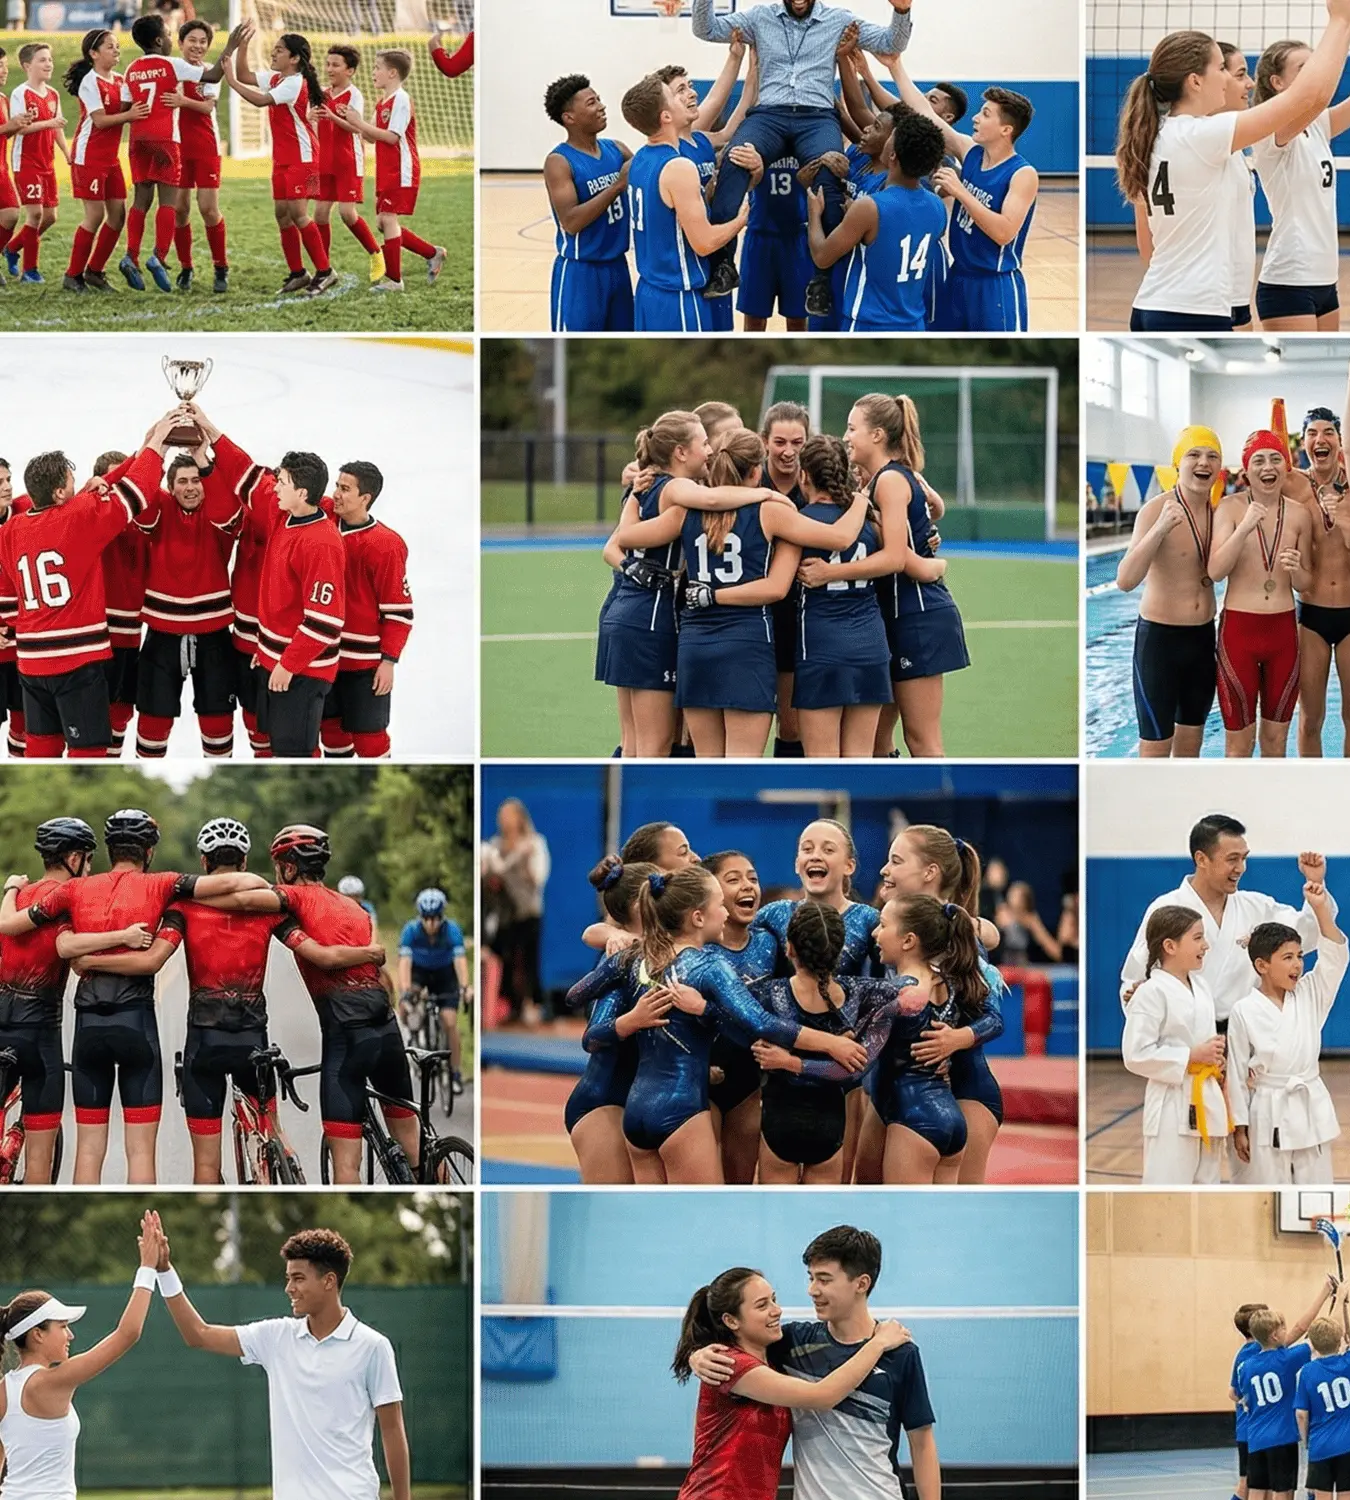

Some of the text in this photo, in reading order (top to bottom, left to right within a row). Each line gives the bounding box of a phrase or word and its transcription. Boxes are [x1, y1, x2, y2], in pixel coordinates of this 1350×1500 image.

[139, 82, 157, 112] 7
[89, 179, 98, 195] 4
[770, 173, 792, 195] 13
[1147, 161, 1175, 217] 4
[1321, 160, 1333, 188] 3
[26, 184, 42, 199] 23
[897, 233, 931, 282] 14
[695, 533, 743, 583] 13
[18, 550, 72, 610] 16
[310, 581, 334, 605] 16
[1251, 1371, 1284, 1407] 10
